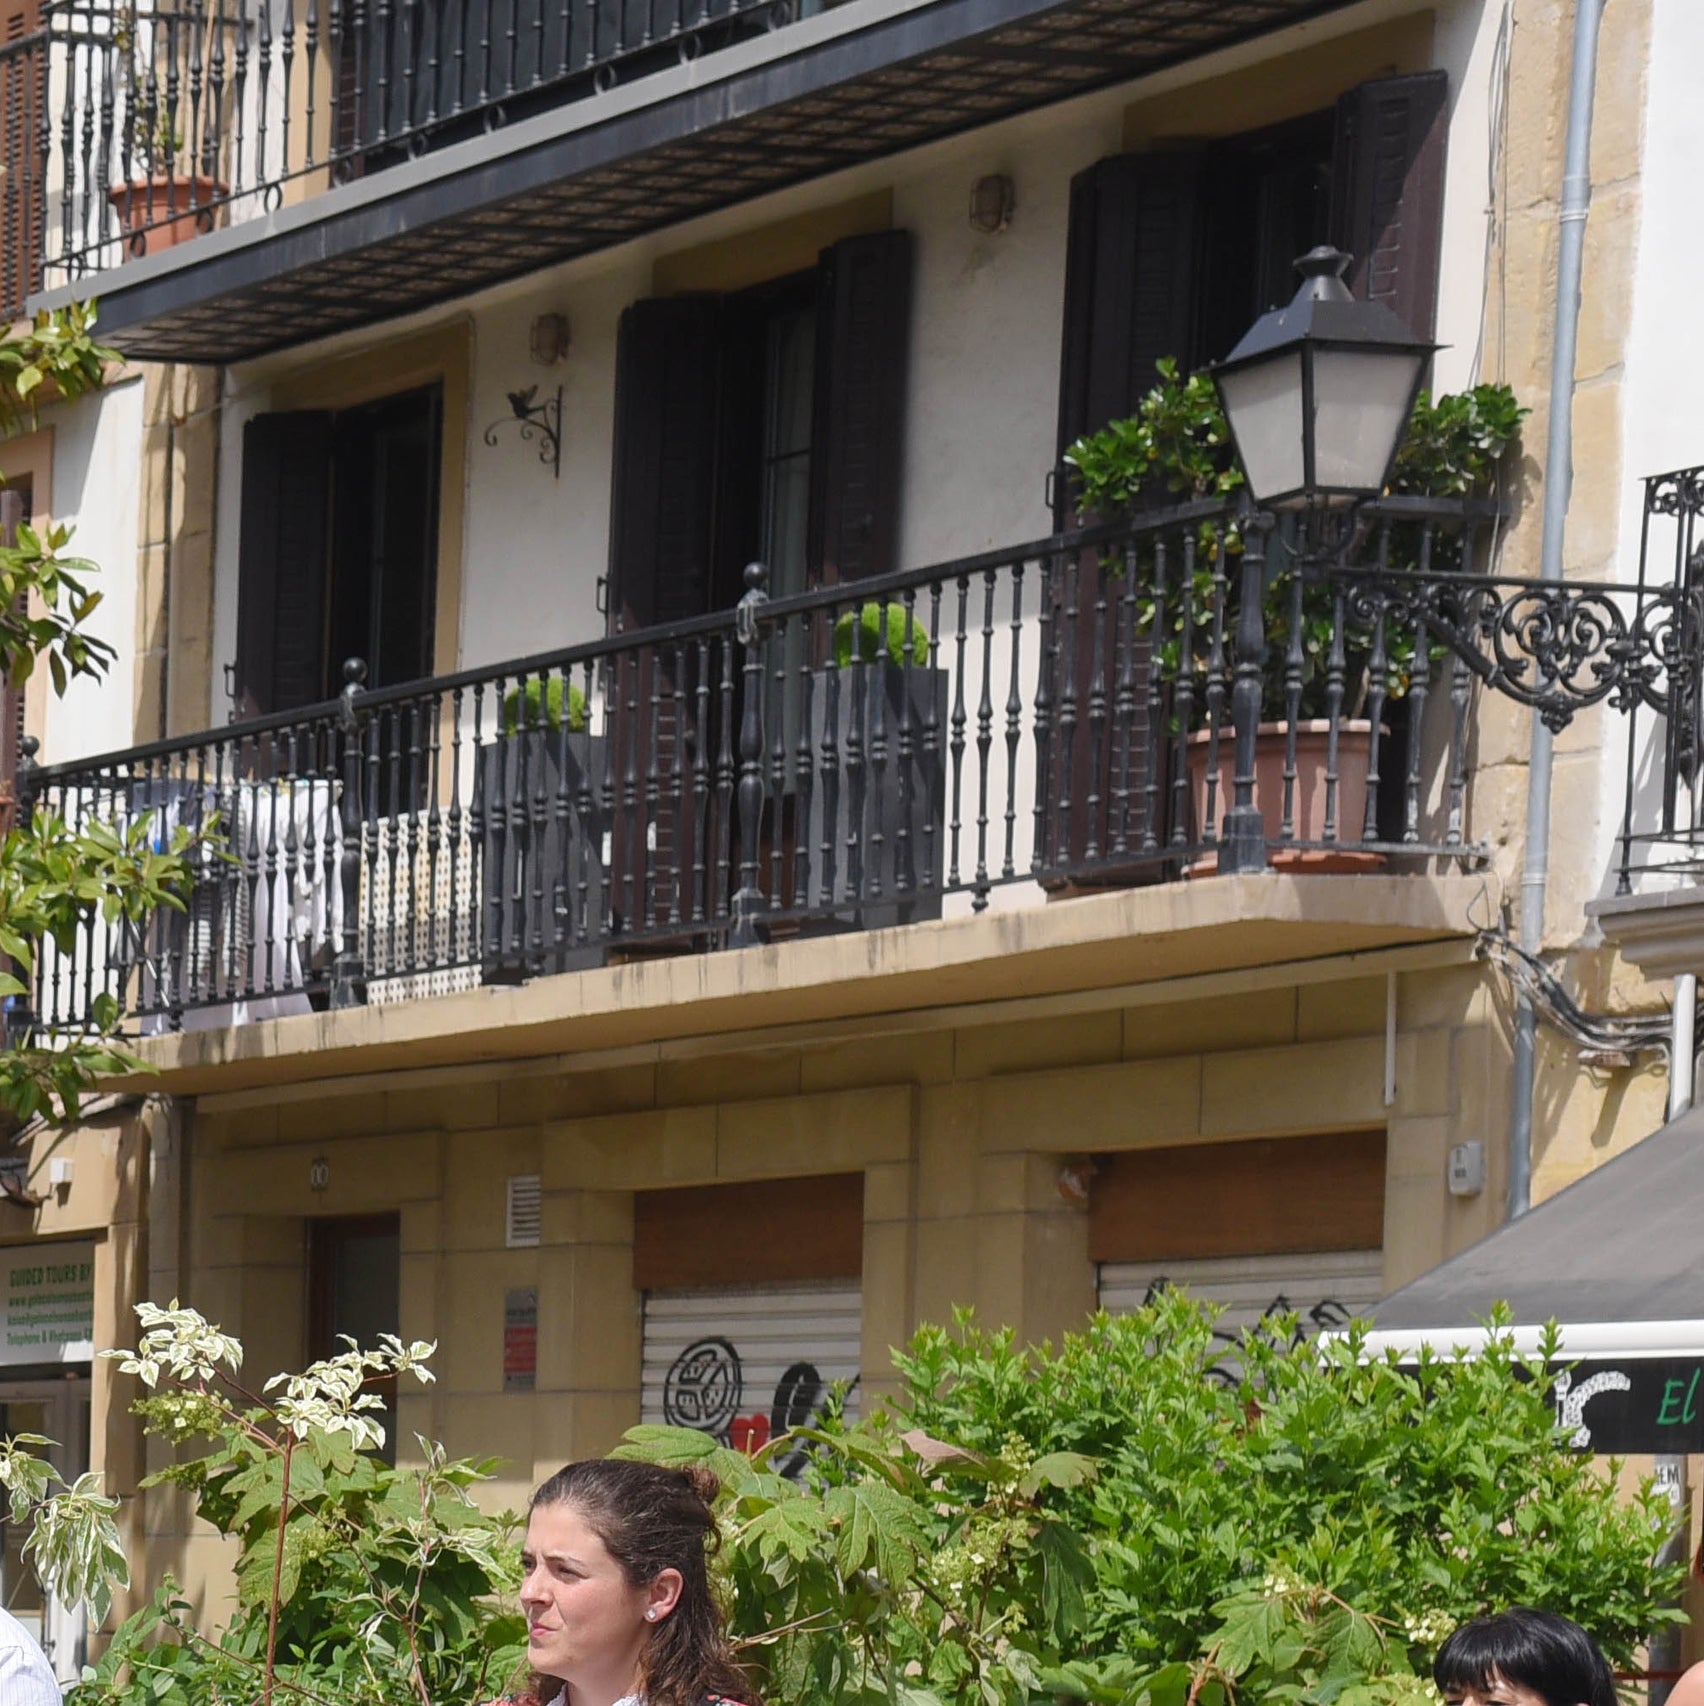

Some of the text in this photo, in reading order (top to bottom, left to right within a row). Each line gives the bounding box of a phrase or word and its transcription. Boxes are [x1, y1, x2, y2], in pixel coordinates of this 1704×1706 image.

[10, 1267, 43, 1287] GUIDED
[46, 1264, 76, 1284] TOURS
[1656, 1366, 1702, 1426] El
